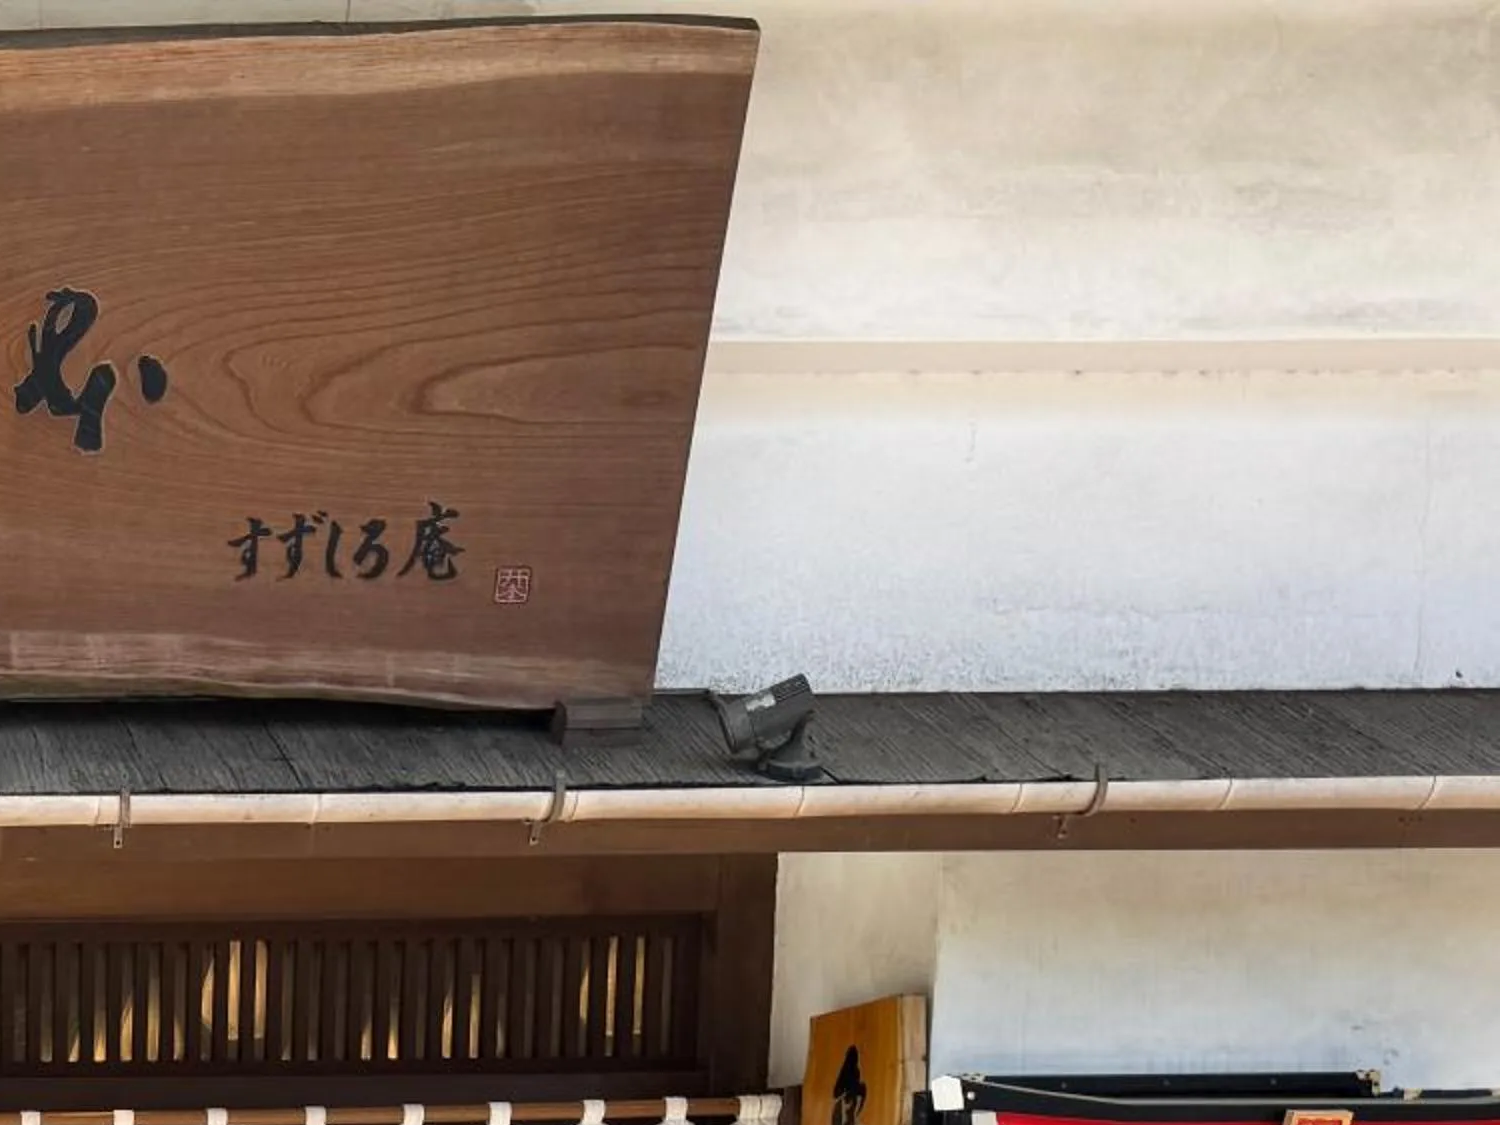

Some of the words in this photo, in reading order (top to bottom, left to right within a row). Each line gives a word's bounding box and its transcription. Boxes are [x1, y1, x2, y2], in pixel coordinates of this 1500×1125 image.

[227, 503, 464, 581] すずしろ庵
